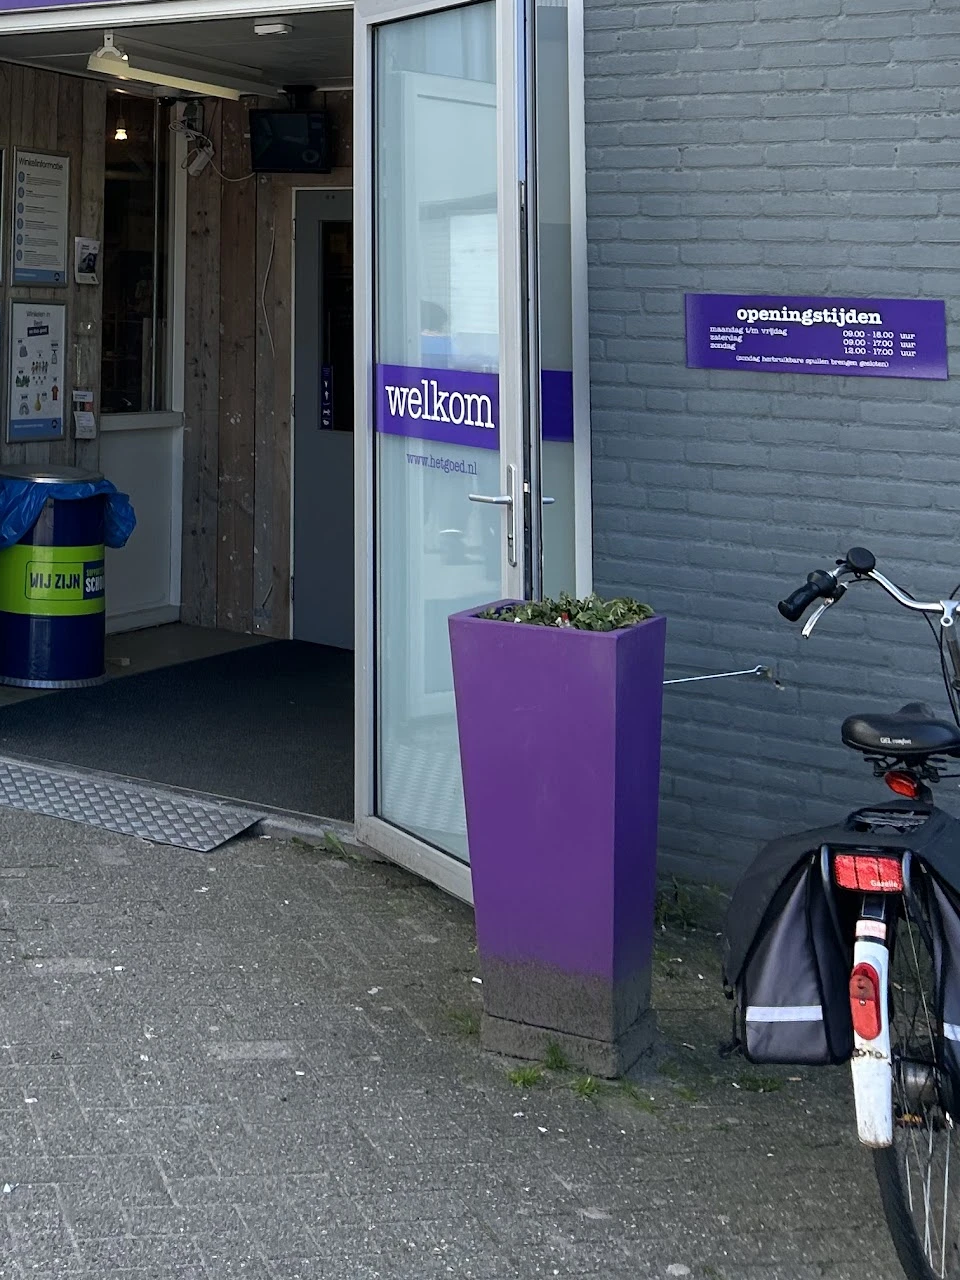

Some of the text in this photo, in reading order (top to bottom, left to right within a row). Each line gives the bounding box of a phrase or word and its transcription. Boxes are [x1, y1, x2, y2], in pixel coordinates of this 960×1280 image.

[18, 157, 64, 171] Winkelinformatie
[736, 306, 882, 327] openingstijden
[710, 326, 744, 334] maandag
[761, 327, 788, 336] vrijdag
[842, 330, 865, 338] 09.00
[872, 330, 894, 339] 18.00
[900, 332, 916, 340] uur
[710, 334, 743, 343] zaterdag
[842, 338, 866, 346] 09.00
[872, 339, 893, 347] 17.00
[900, 341, 916, 349] uur
[710, 342, 736, 351] zondag
[844, 346, 866, 355] 12.00
[873, 348, 893, 356] 17.00
[735, 355, 760, 363] (zondag
[761, 356, 804, 364] herbruikbare
[805, 358, 829, 366] spullen
[830, 358, 858, 367] brengen
[385, 379, 495, 429] welkom
[406, 453, 478, 475] www.hetgoed.nl
[30, 572, 80, 589] WIJ ZIJN
[870, 879, 898, 888] Gazelle
